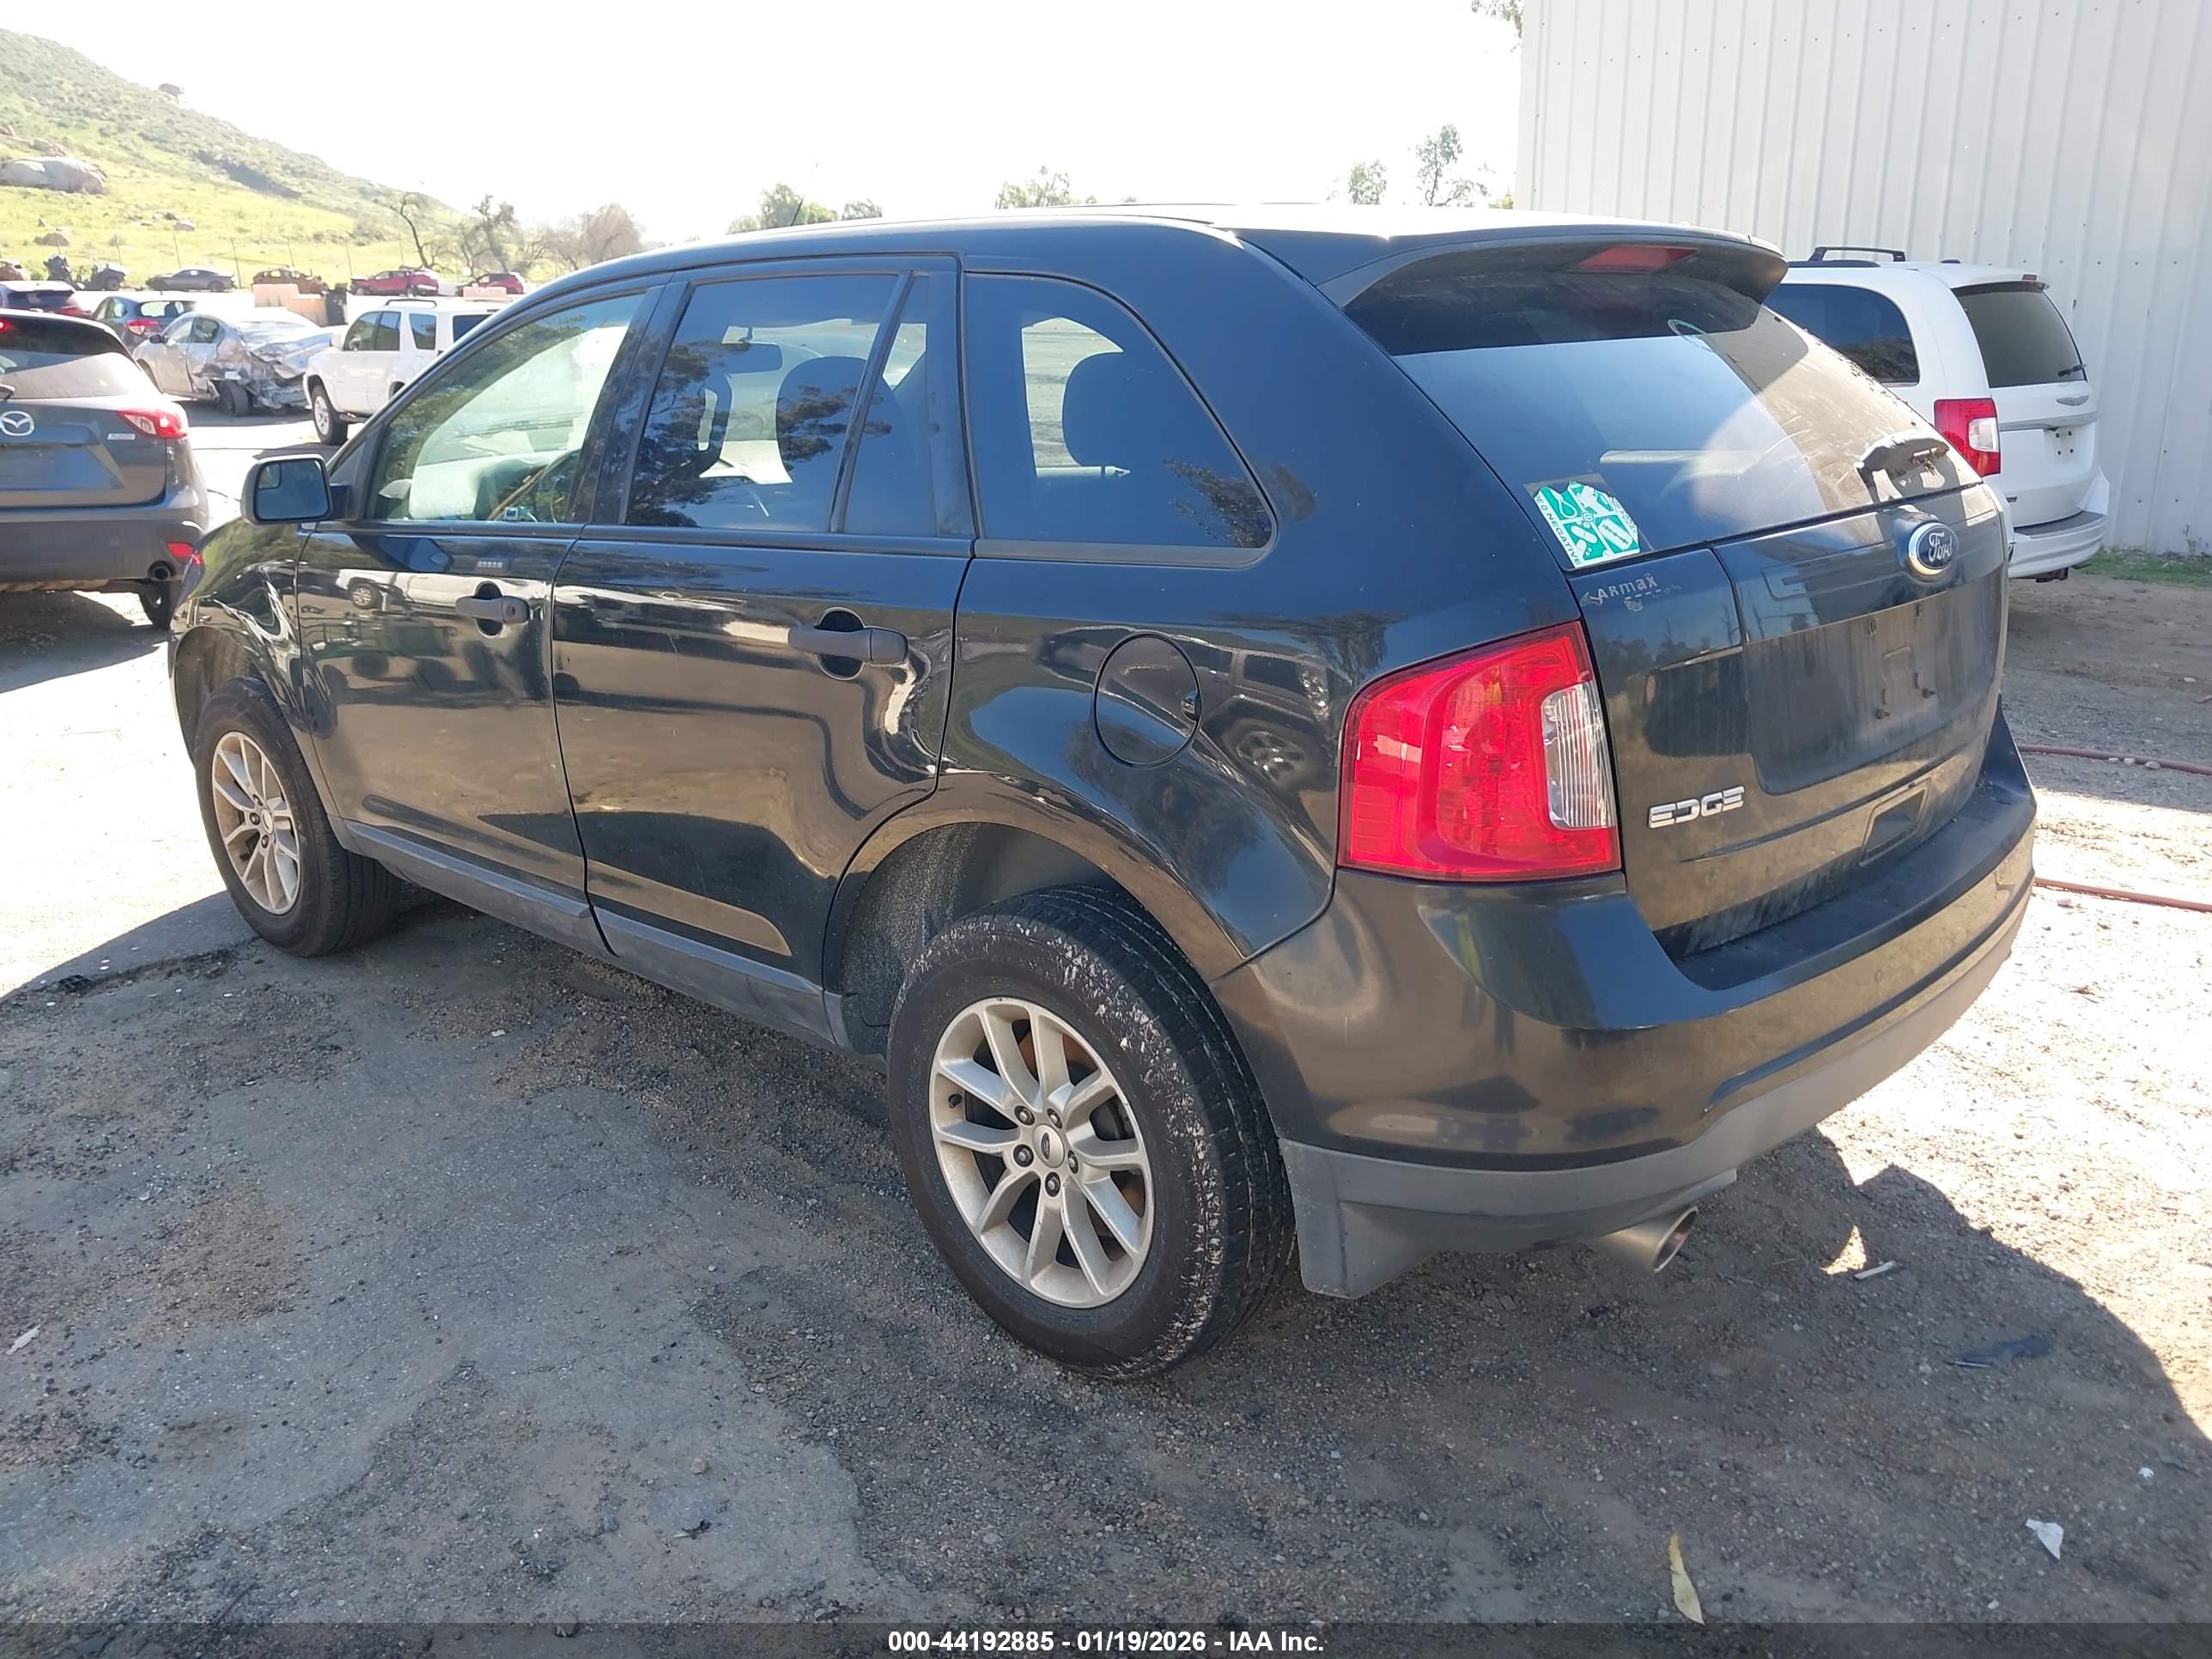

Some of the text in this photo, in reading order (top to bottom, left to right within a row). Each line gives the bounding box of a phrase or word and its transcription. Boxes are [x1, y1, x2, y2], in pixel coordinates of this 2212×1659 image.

[1547, 513, 1582, 565] NEGATIVE
[1928, 532, 1953, 562] Ford
[1649, 786, 1745, 829] EDGE
